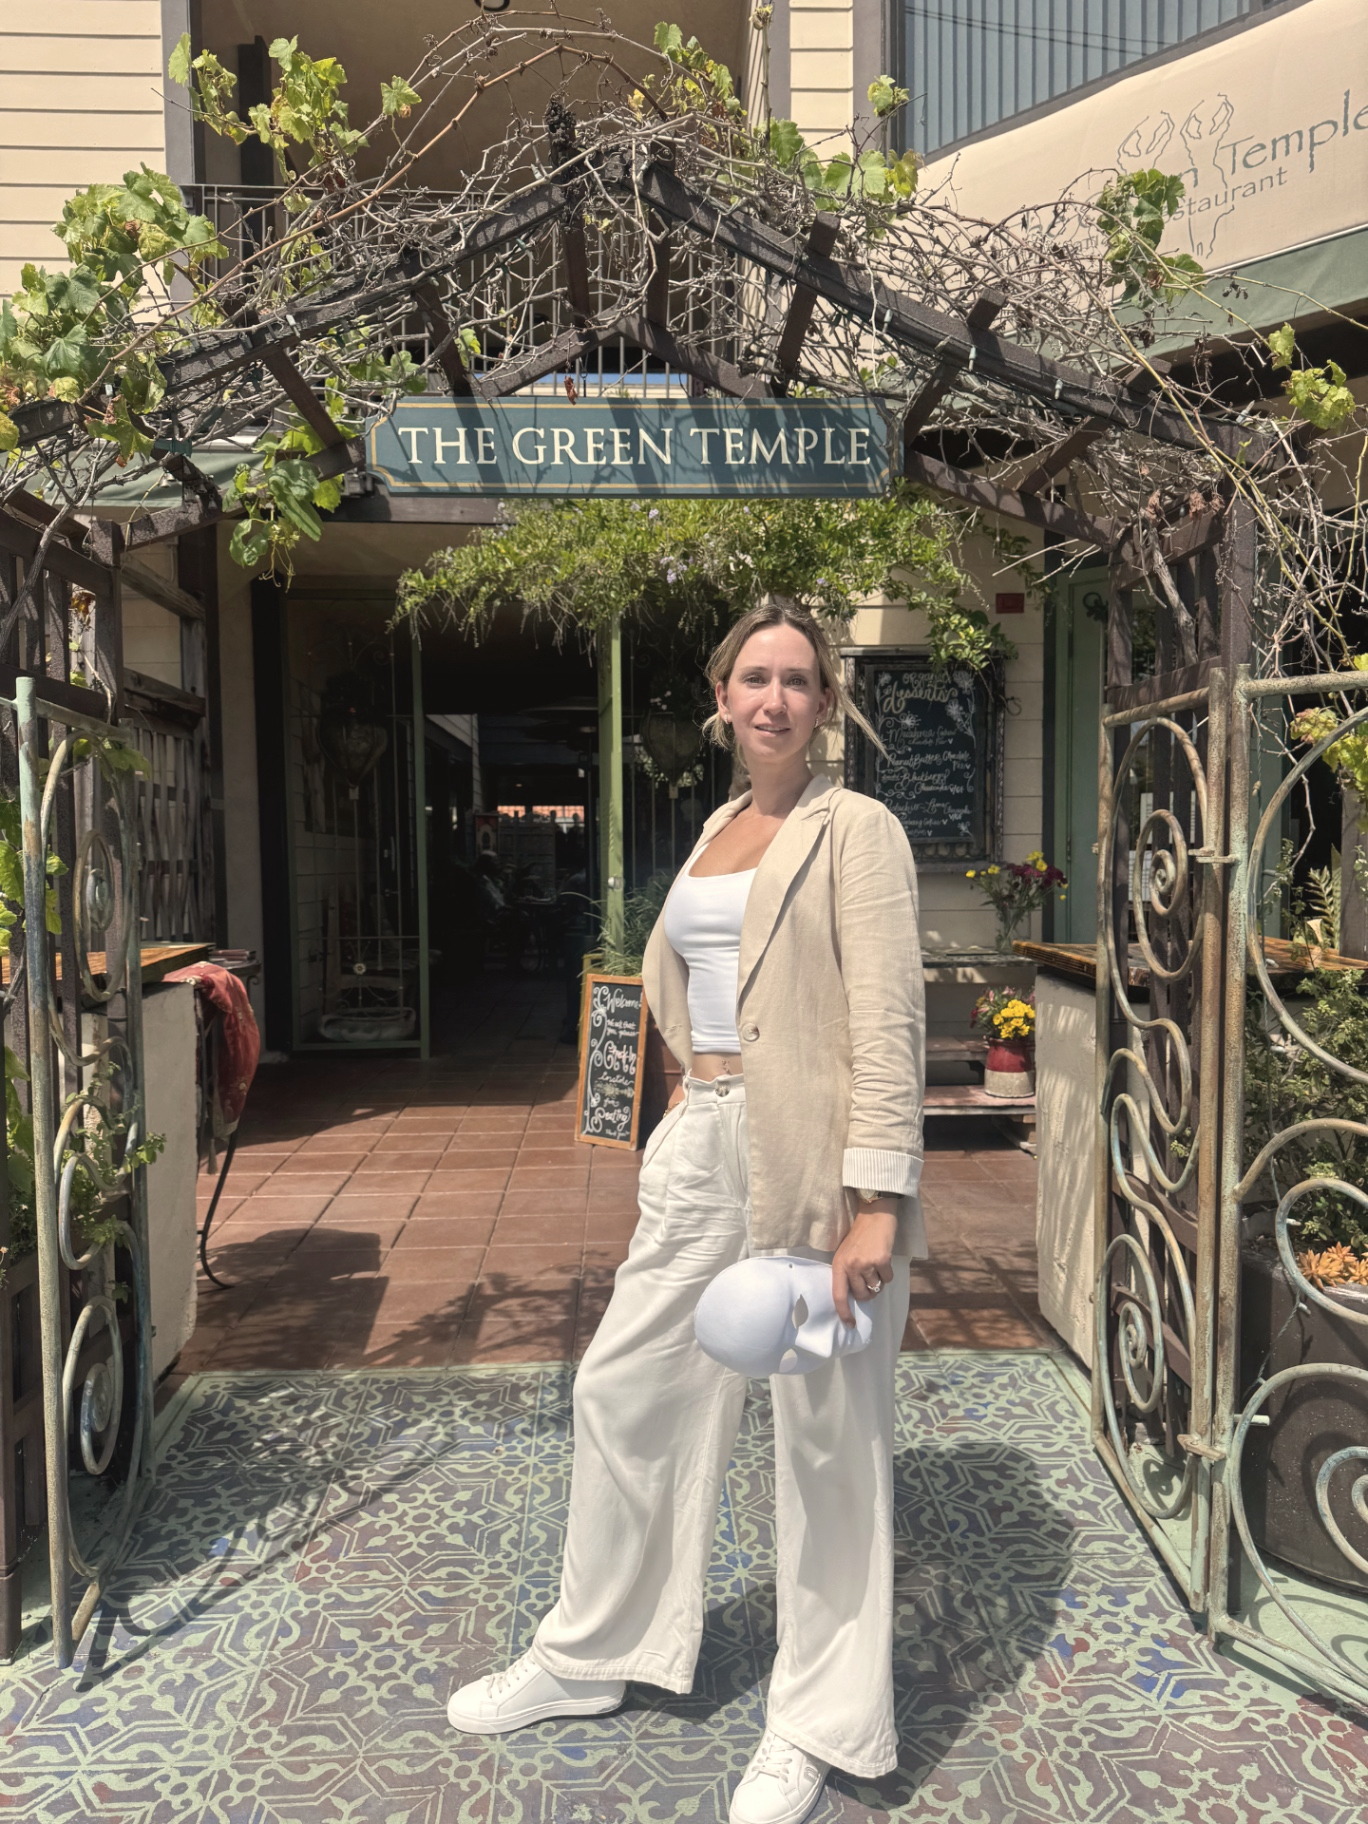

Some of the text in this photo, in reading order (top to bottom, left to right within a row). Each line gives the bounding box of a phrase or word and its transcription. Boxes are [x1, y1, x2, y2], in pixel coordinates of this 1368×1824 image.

[1219, 88, 1368, 174] Temple
[1163, 166, 1288, 223] staurant
[398, 427, 870, 465] THE GREEN TEMPLE
